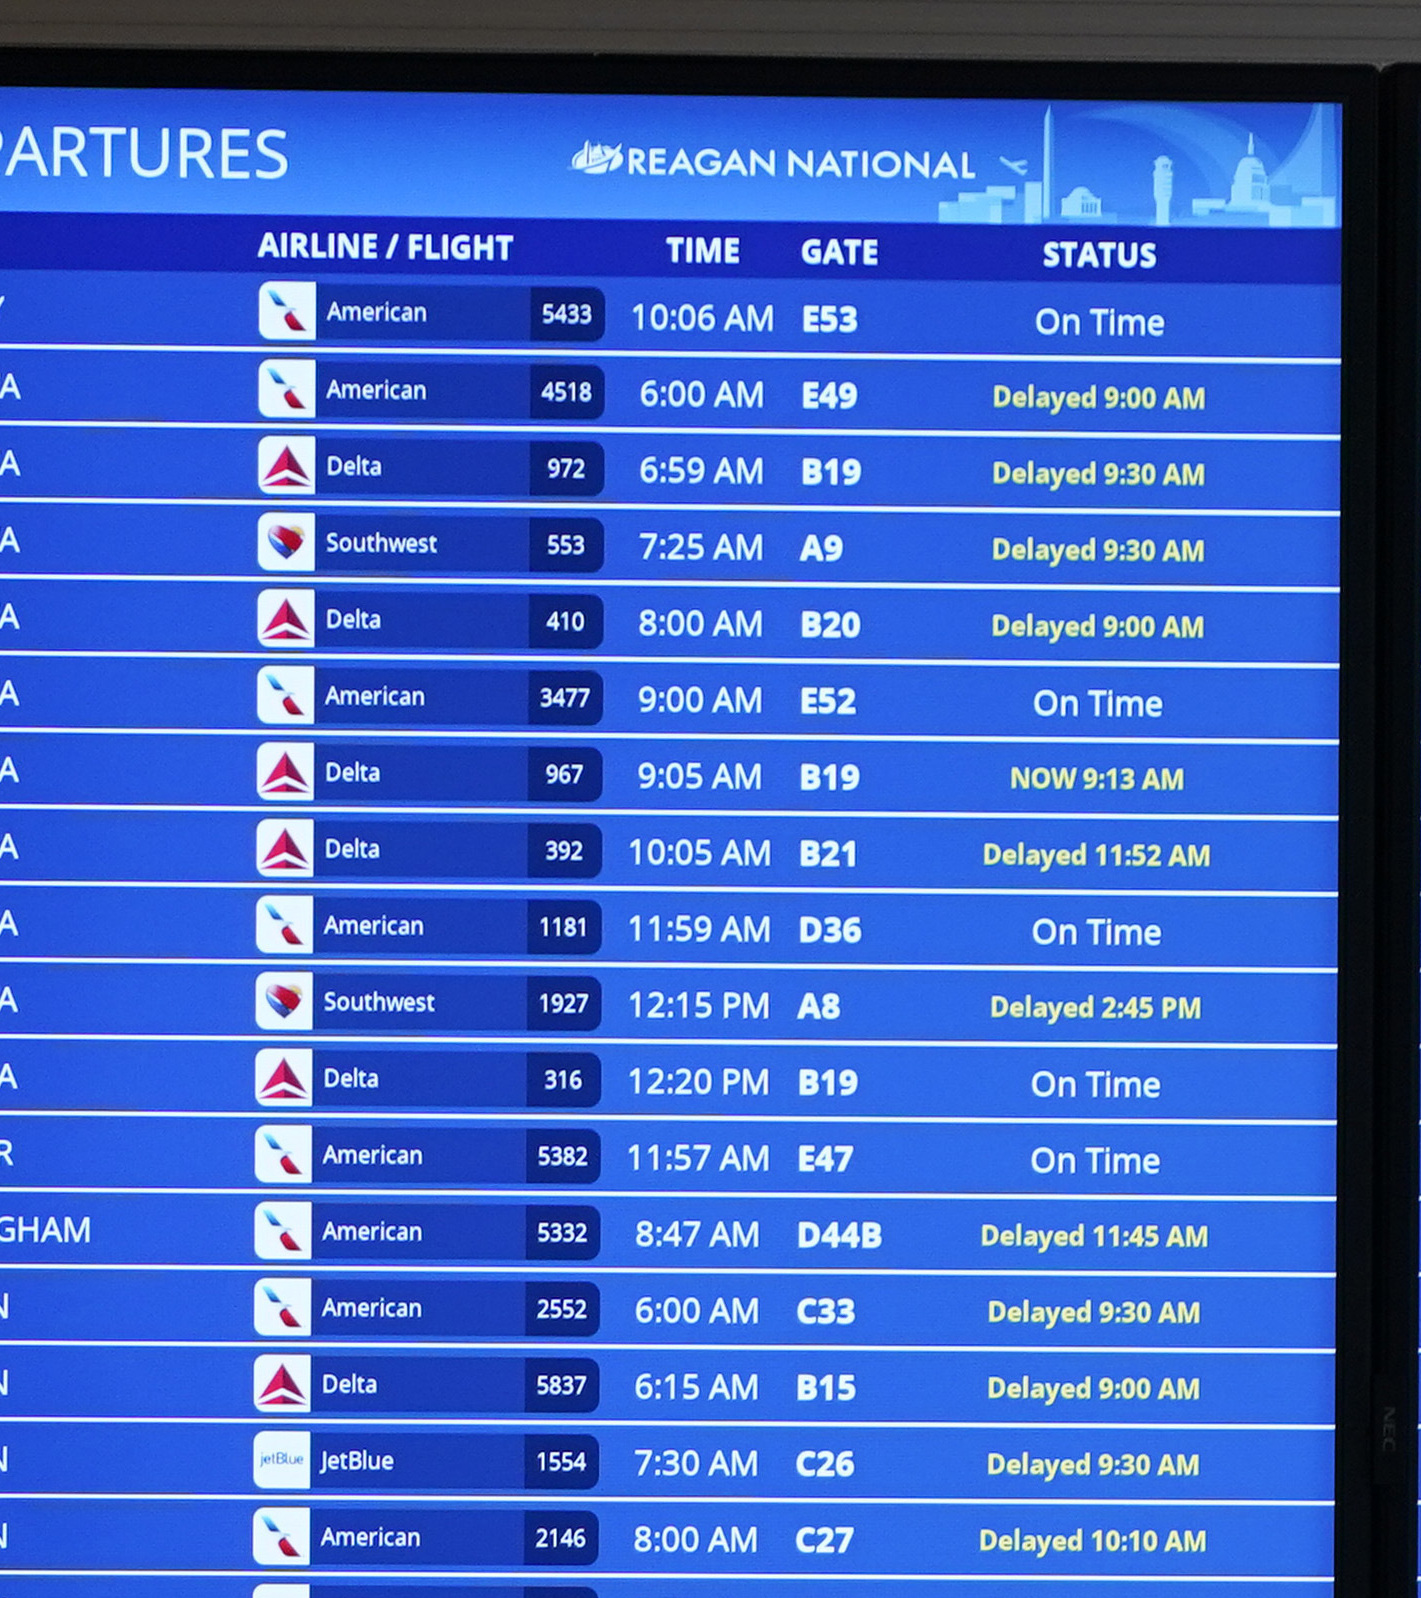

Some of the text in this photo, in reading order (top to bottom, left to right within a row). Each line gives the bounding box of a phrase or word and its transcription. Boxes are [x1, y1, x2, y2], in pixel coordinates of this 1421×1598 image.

[0, 125, 288, 180] ARTURES
[628, 147, 976, 179] REAGAN NATIONAL
[257, 231, 1157, 269] AIRLINE / FLIGHT TIME GATE STATUS
[326, 760, 1184, 791] Delta 967 9:05 AM B19 NOW 9:13 AM
[322, 1220, 423, 1242] American
[537, 1222, 588, 1243] 5332
[635, 1220, 702, 1248] 8:47
[708, 1220, 759, 1248] AM
[798, 1221, 883, 1249] D44B
[981, 1222, 1085, 1254] Delayed
[1093, 1224, 1160, 1248] 11:45
[1165, 1225, 1208, 1248] AM
[1383, 1406, 1396, 1452] NEC
[260, 1449, 1200, 1483] jetBlue JetBlue 1554 7:30 AM C26 Delayed 9:30 AM
